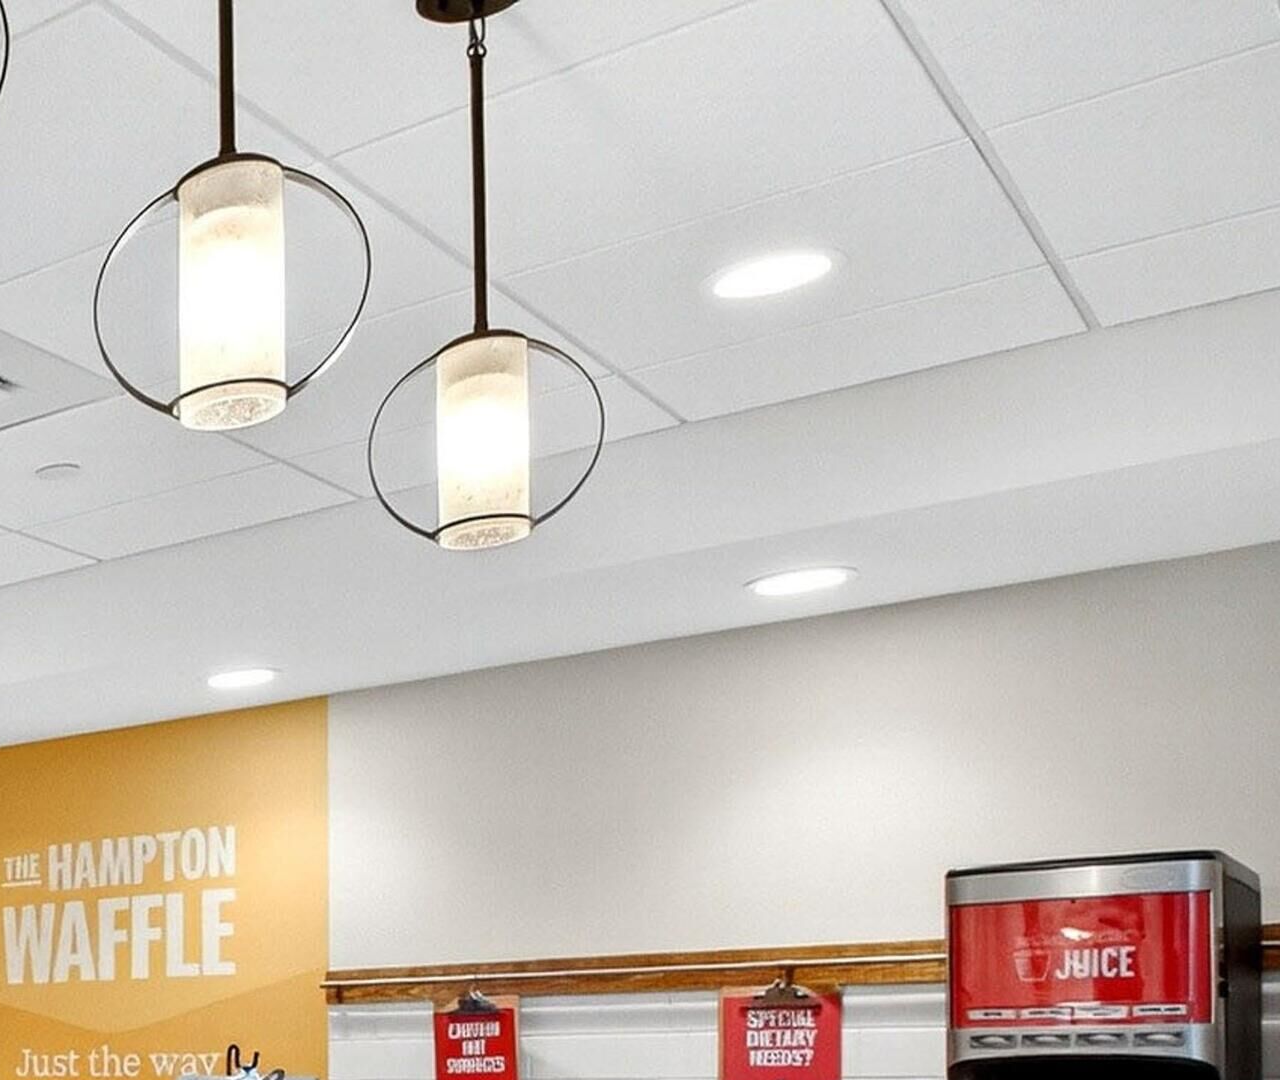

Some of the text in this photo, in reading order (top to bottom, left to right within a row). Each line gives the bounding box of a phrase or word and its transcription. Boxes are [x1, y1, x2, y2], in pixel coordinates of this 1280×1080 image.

[3, 825, 237, 891] THE HAMPTON
[2, 888, 237, 985] WAFFLE
[1055, 946, 1137, 980] JUICE
[15, 1048, 80, 1078] Just
[89, 1044, 141, 1077] the
